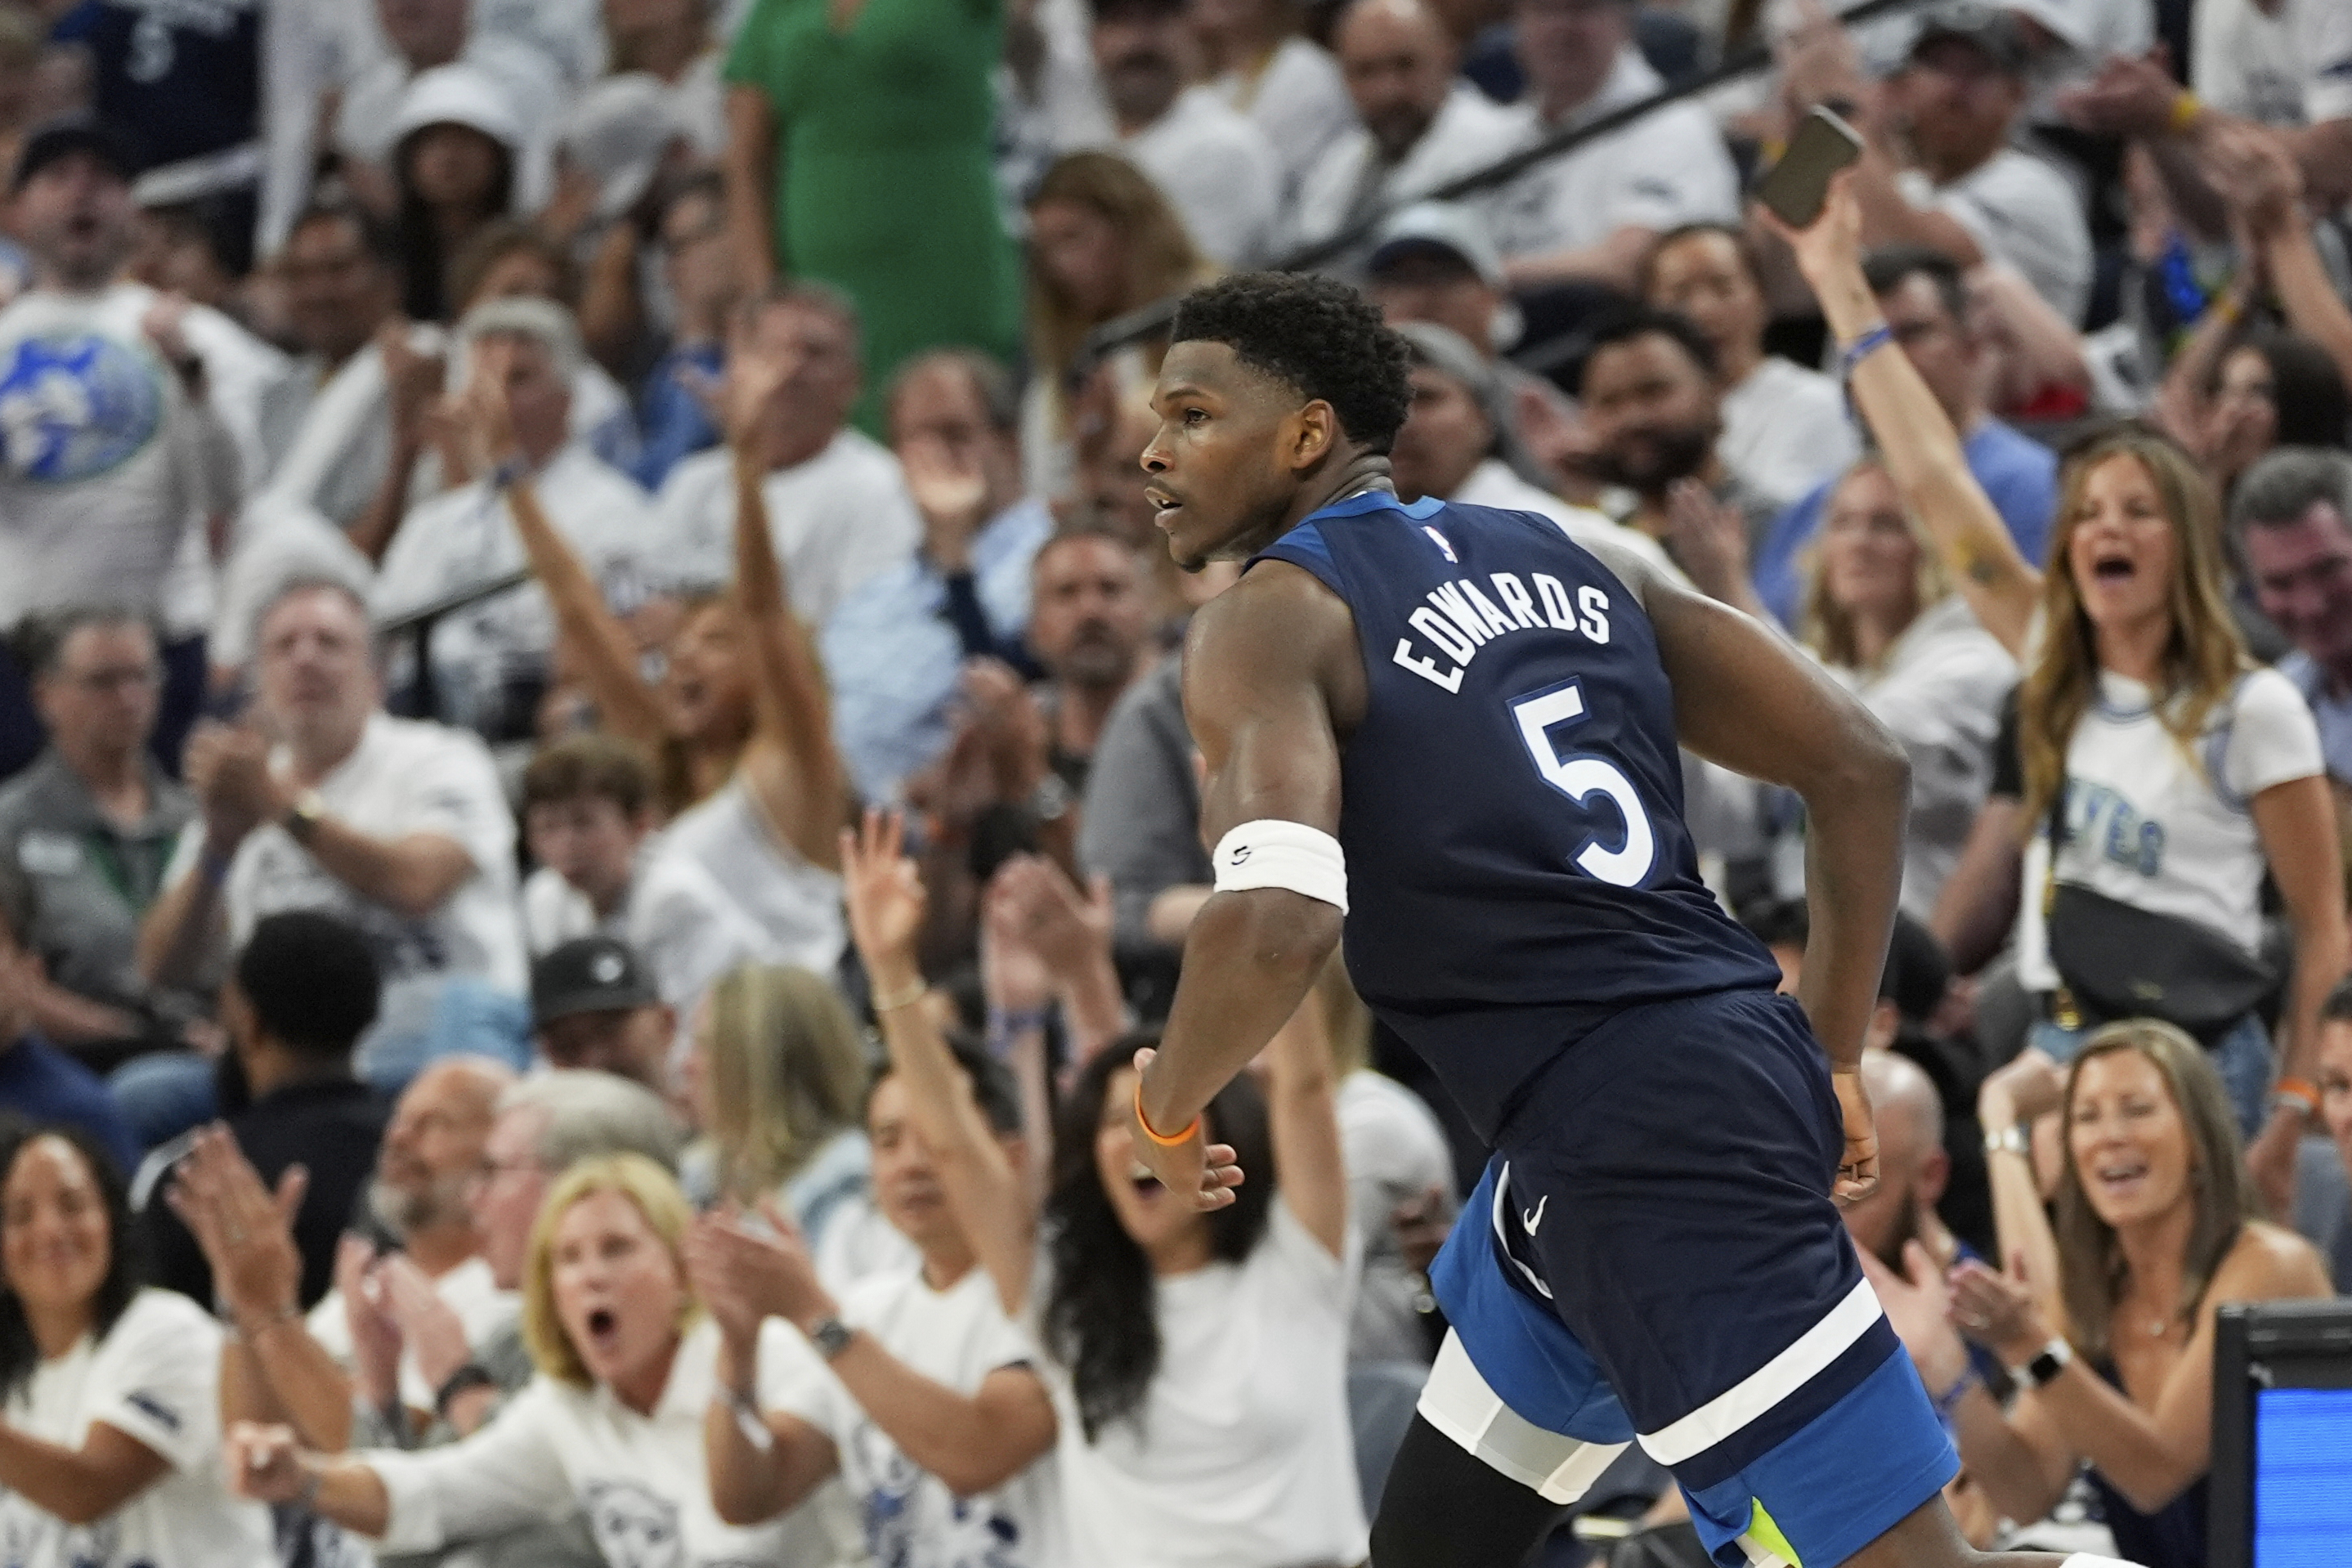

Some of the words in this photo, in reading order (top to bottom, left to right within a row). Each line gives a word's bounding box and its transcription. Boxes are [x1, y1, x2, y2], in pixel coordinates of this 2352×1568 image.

[1392, 572, 1610, 694] EDWARDS
[1508, 678, 1657, 889] 5
[1230, 844, 1252, 866] 5
